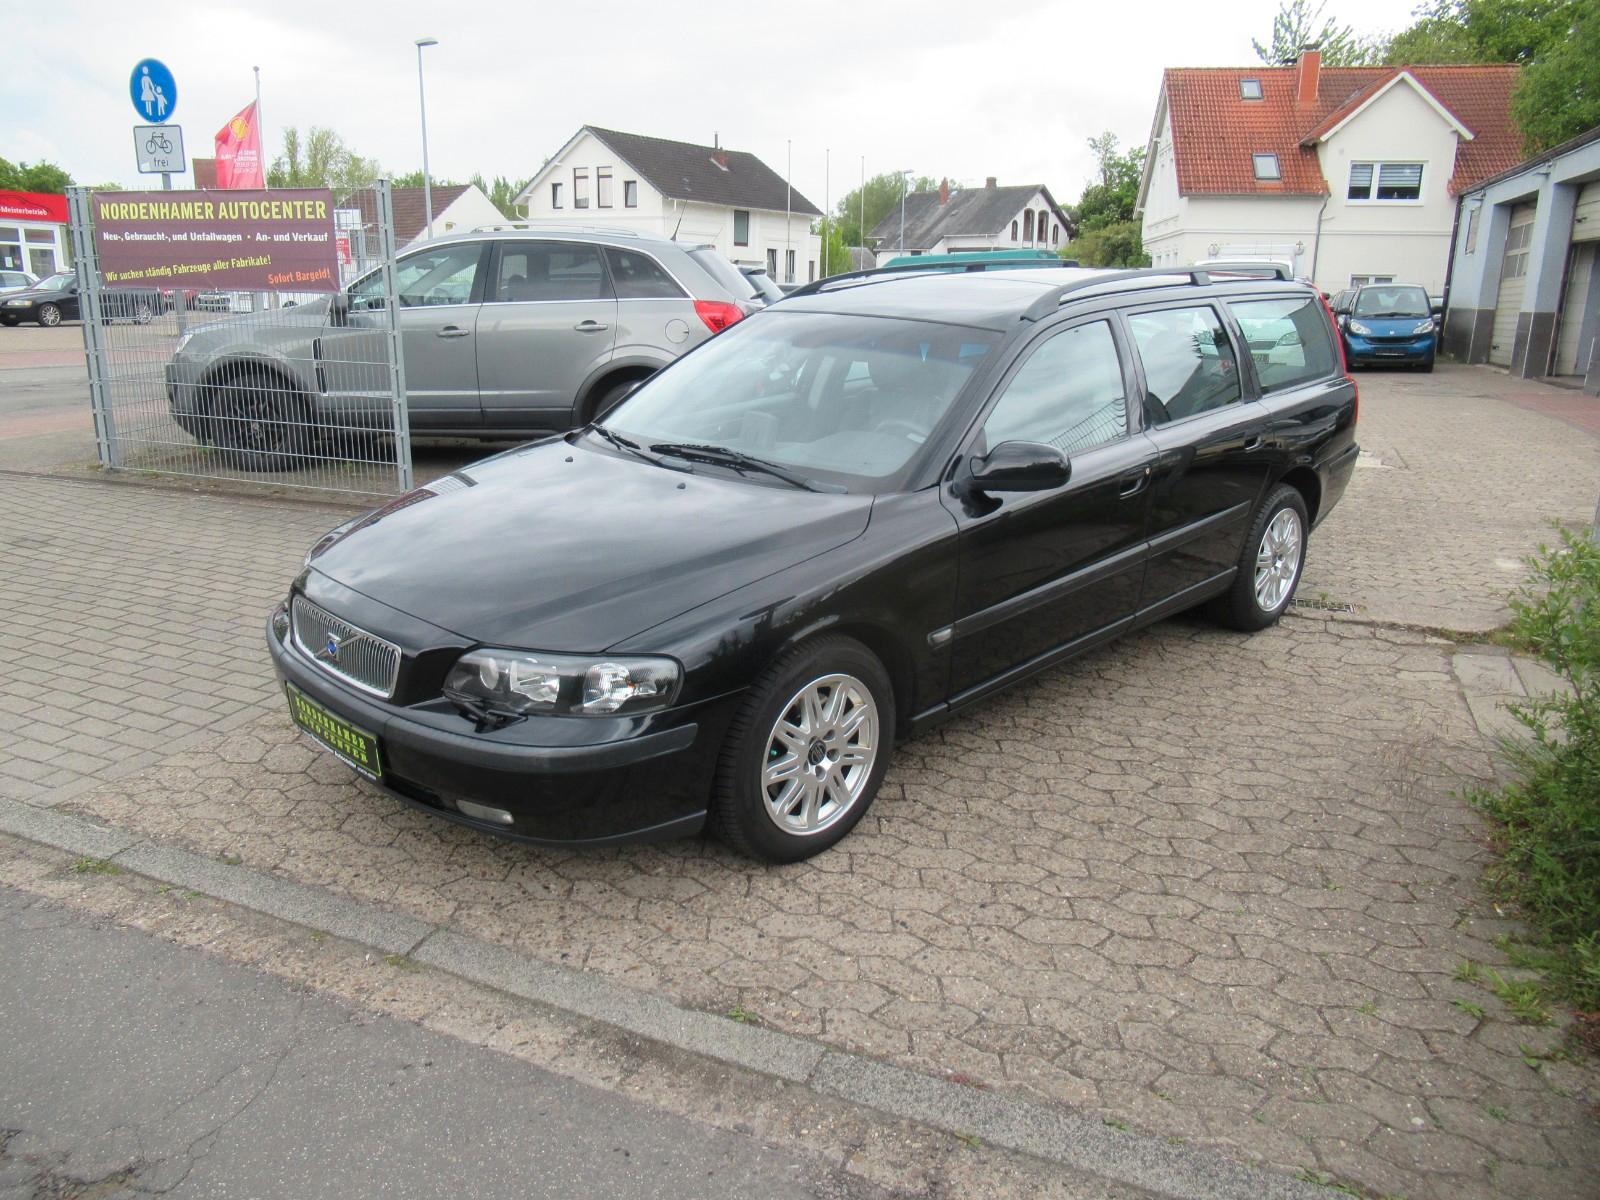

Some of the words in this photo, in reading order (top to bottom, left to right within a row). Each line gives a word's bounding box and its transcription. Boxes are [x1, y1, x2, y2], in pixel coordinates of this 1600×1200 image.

[153, 157, 169, 167] frei
[100, 201, 214, 220] NORDENHAMER
[218, 200, 327, 219] AUTOCENTER
[103, 232, 124, 242] Neu-,
[124, 232, 171, 242] Gebraucht-,
[172, 232, 188, 241] und
[190, 232, 242, 242] Unfallwagen
[255, 232, 271, 241] An-
[273, 232, 290, 241] und
[292, 232, 328, 241] Verkauf
[105, 271, 118, 282] Wir
[120, 269, 144, 280] suchen
[146, 264, 172, 277] ständig
[172, 263, 211, 275] Fahrzeuge
[213, 259, 229, 271] aller
[231, 254, 272, 269] Fabrikate!
[268, 271, 294, 285] Sofort
[295, 267, 331, 282] Bargeld!
